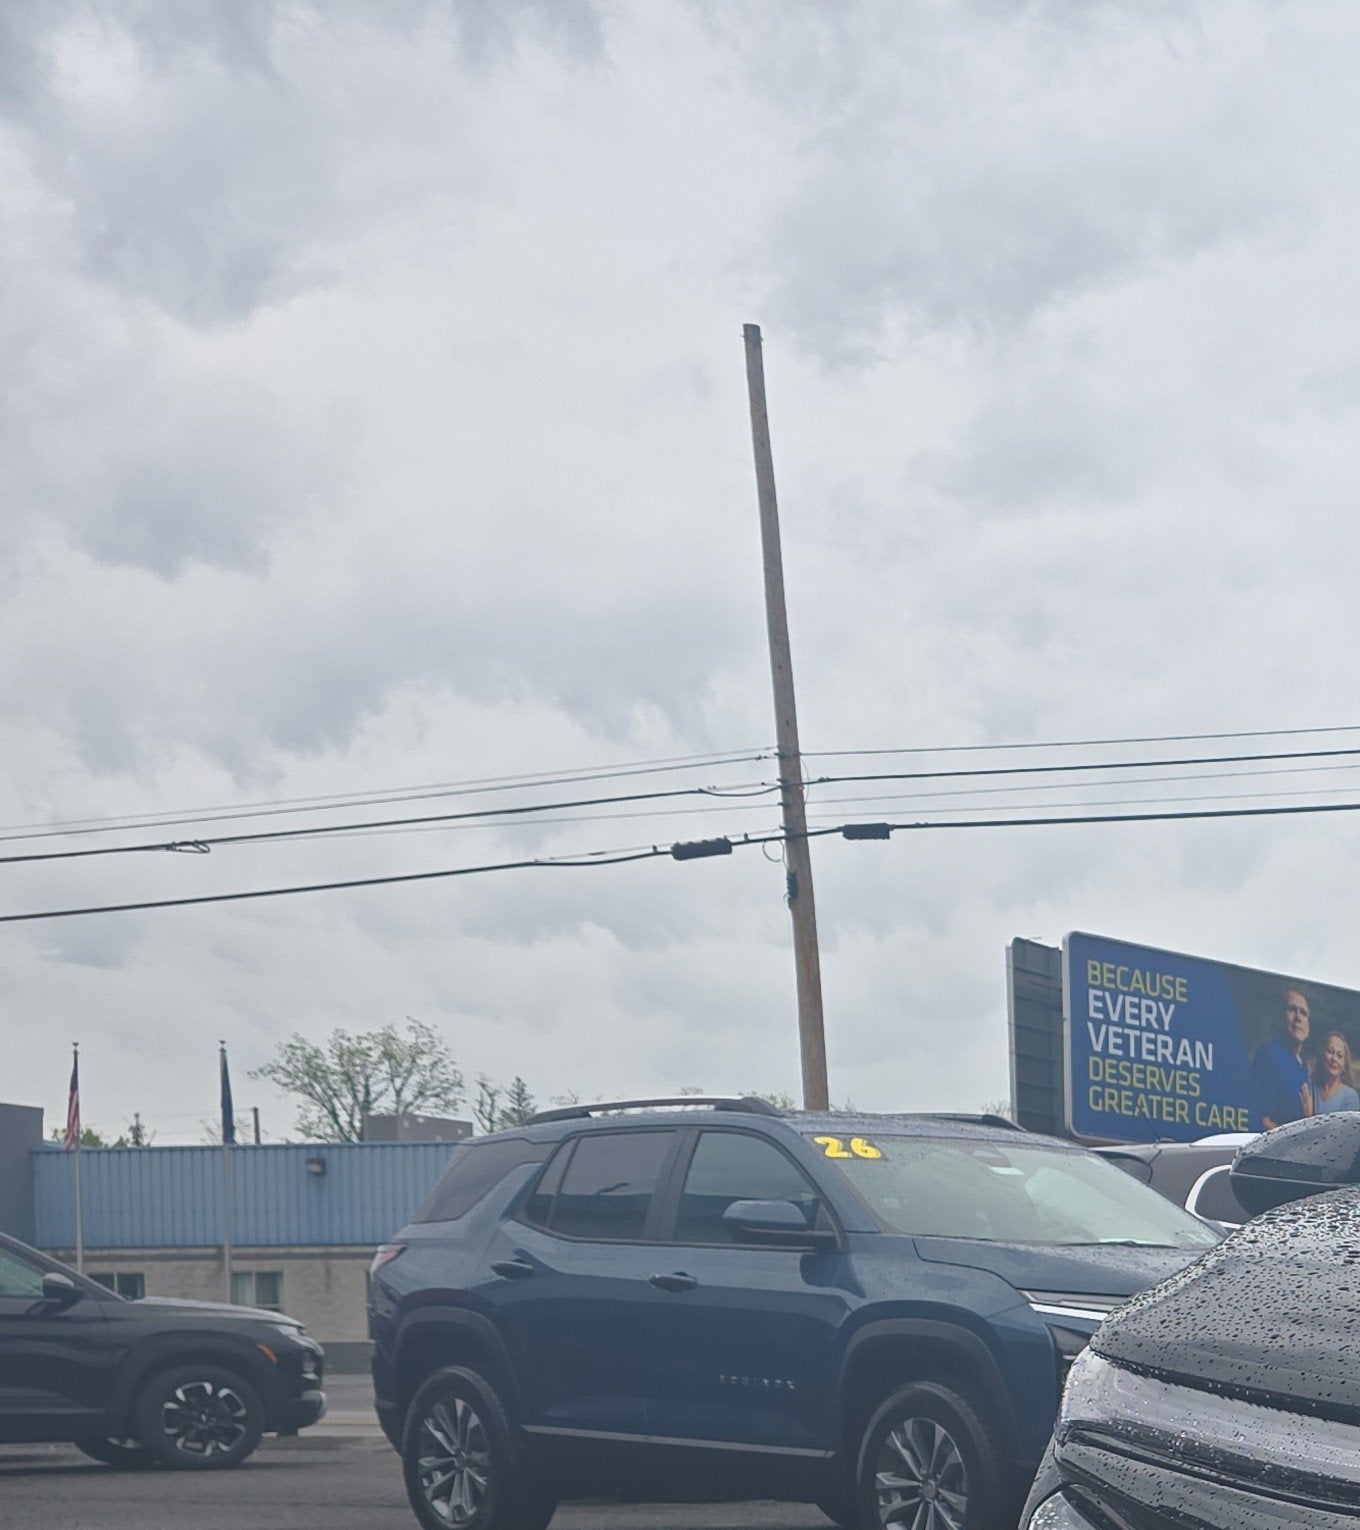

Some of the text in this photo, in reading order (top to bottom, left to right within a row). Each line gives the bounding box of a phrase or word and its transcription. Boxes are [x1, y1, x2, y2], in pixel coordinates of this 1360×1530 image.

[1087, 959, 1188, 1002] BECAUSE
[1088, 988, 1175, 1031] EVERY
[1087, 1021, 1213, 1071] VETERAN
[1088, 1056, 1201, 1097] DESERVES
[1088, 1085, 1250, 1132] GREATER CARE
[813, 1136, 882, 1158] 26
